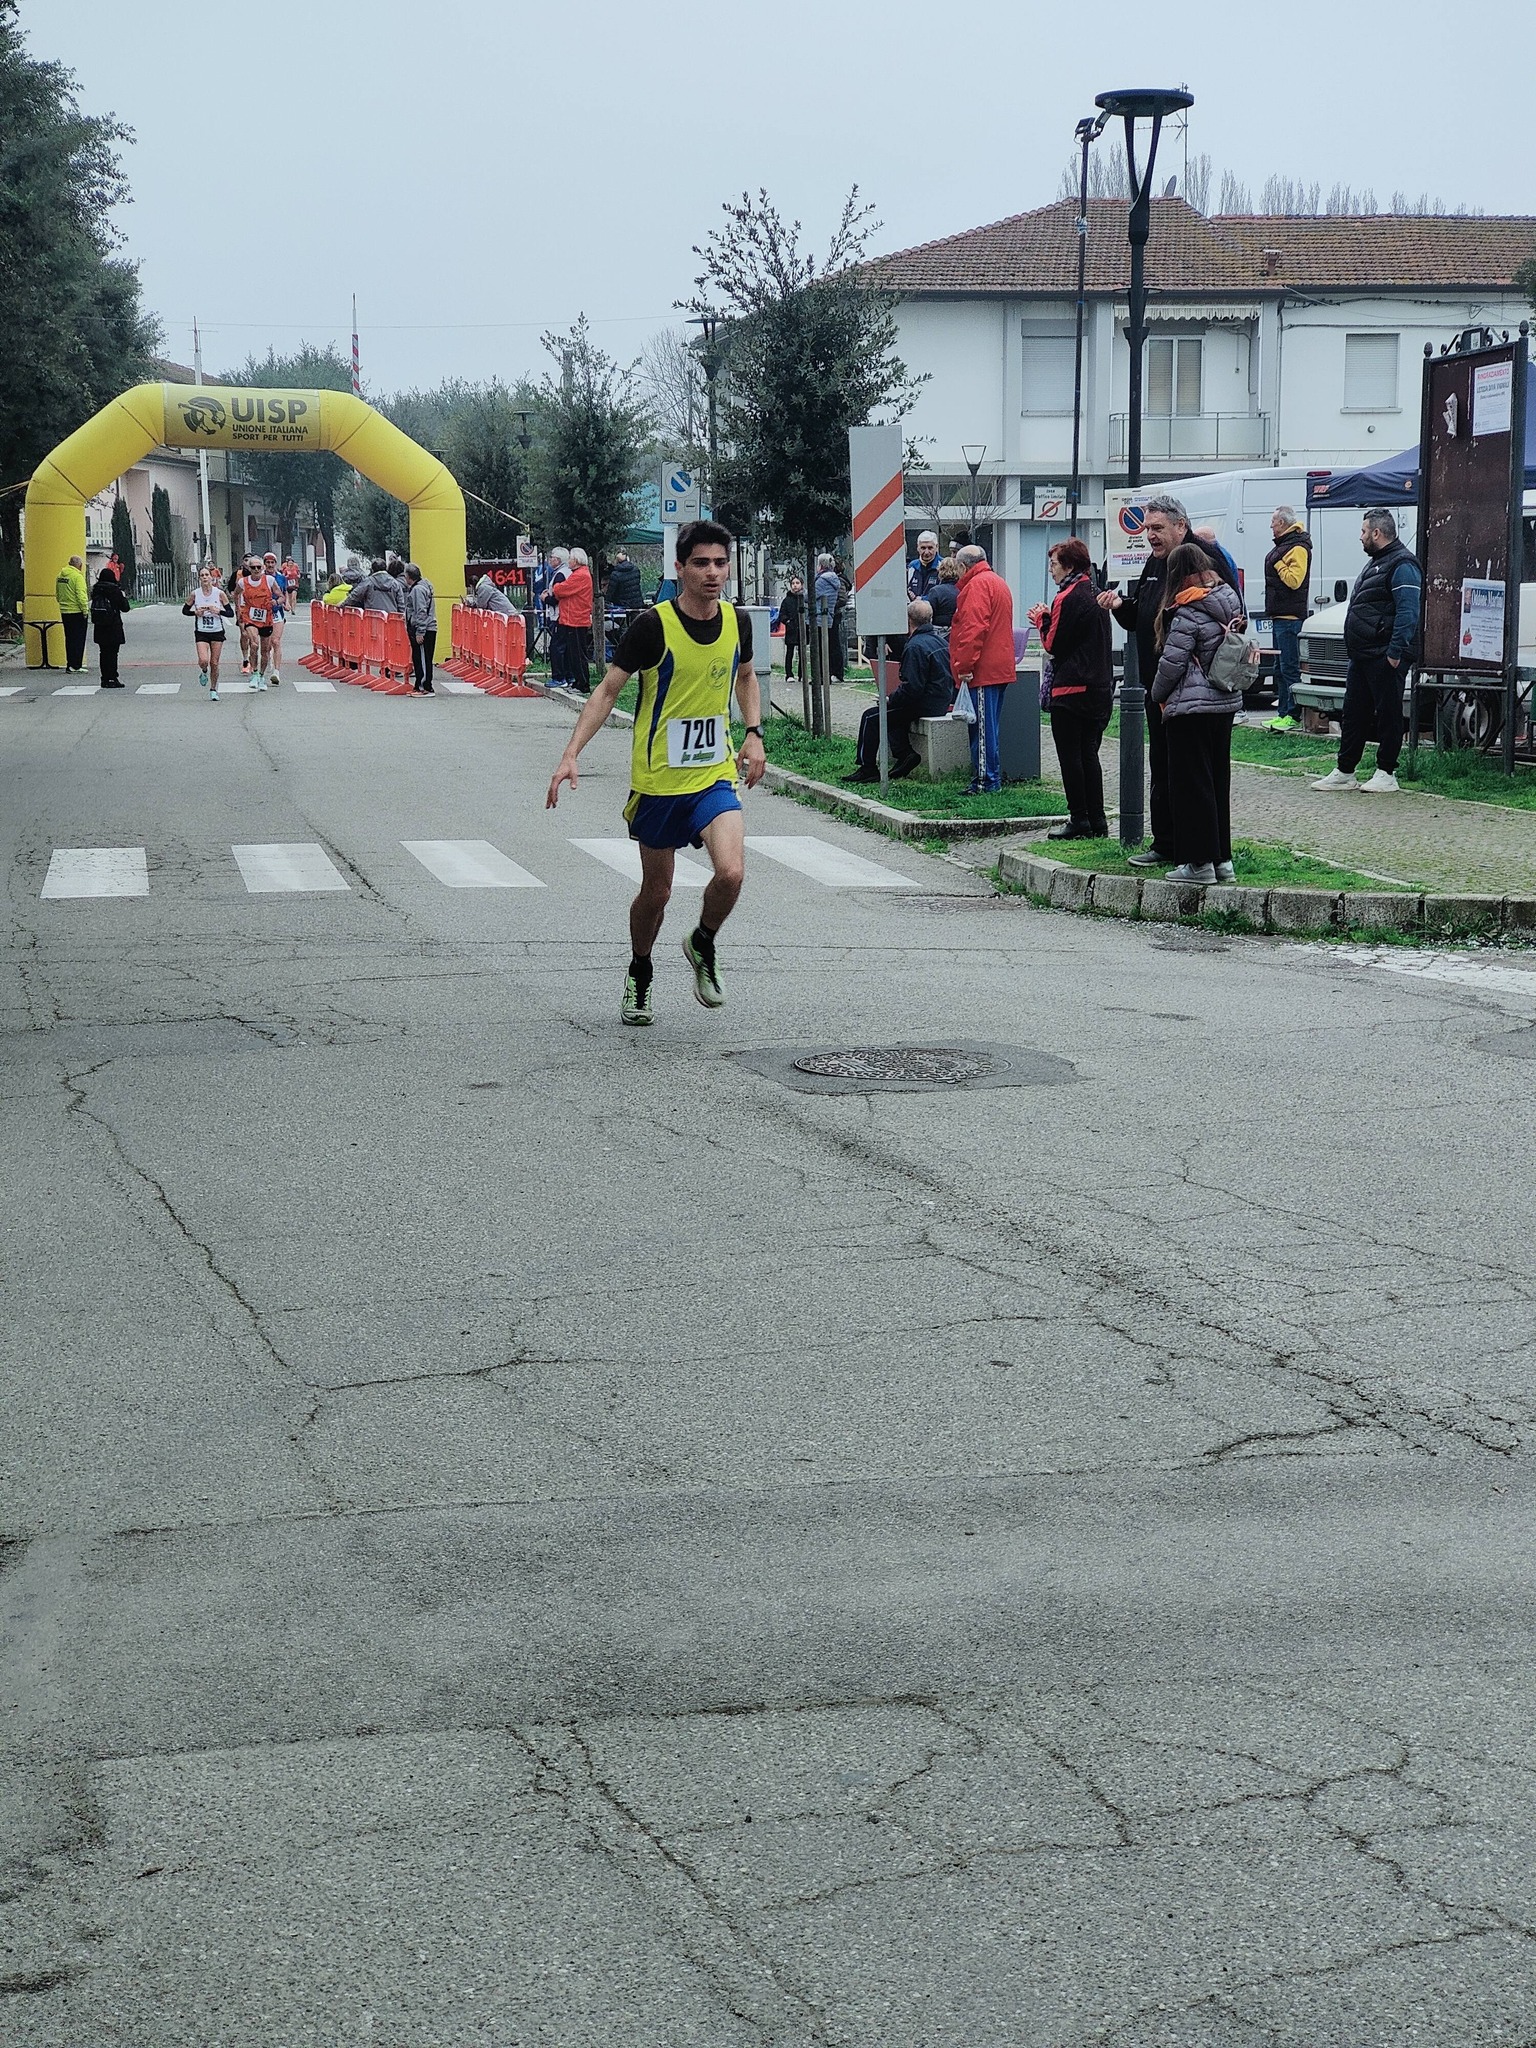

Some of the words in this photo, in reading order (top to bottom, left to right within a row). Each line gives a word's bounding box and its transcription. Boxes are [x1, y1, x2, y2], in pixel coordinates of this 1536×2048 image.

[231, 397, 307, 424] UISP
[232, 424, 266, 433] UNIONE
[269, 426, 308, 434] ITALIANA
[232, 433, 259, 441] SPORT
[263, 433, 278, 441] PER
[282, 434, 304, 442] TUTTI
[681, 718, 715, 750] 720
